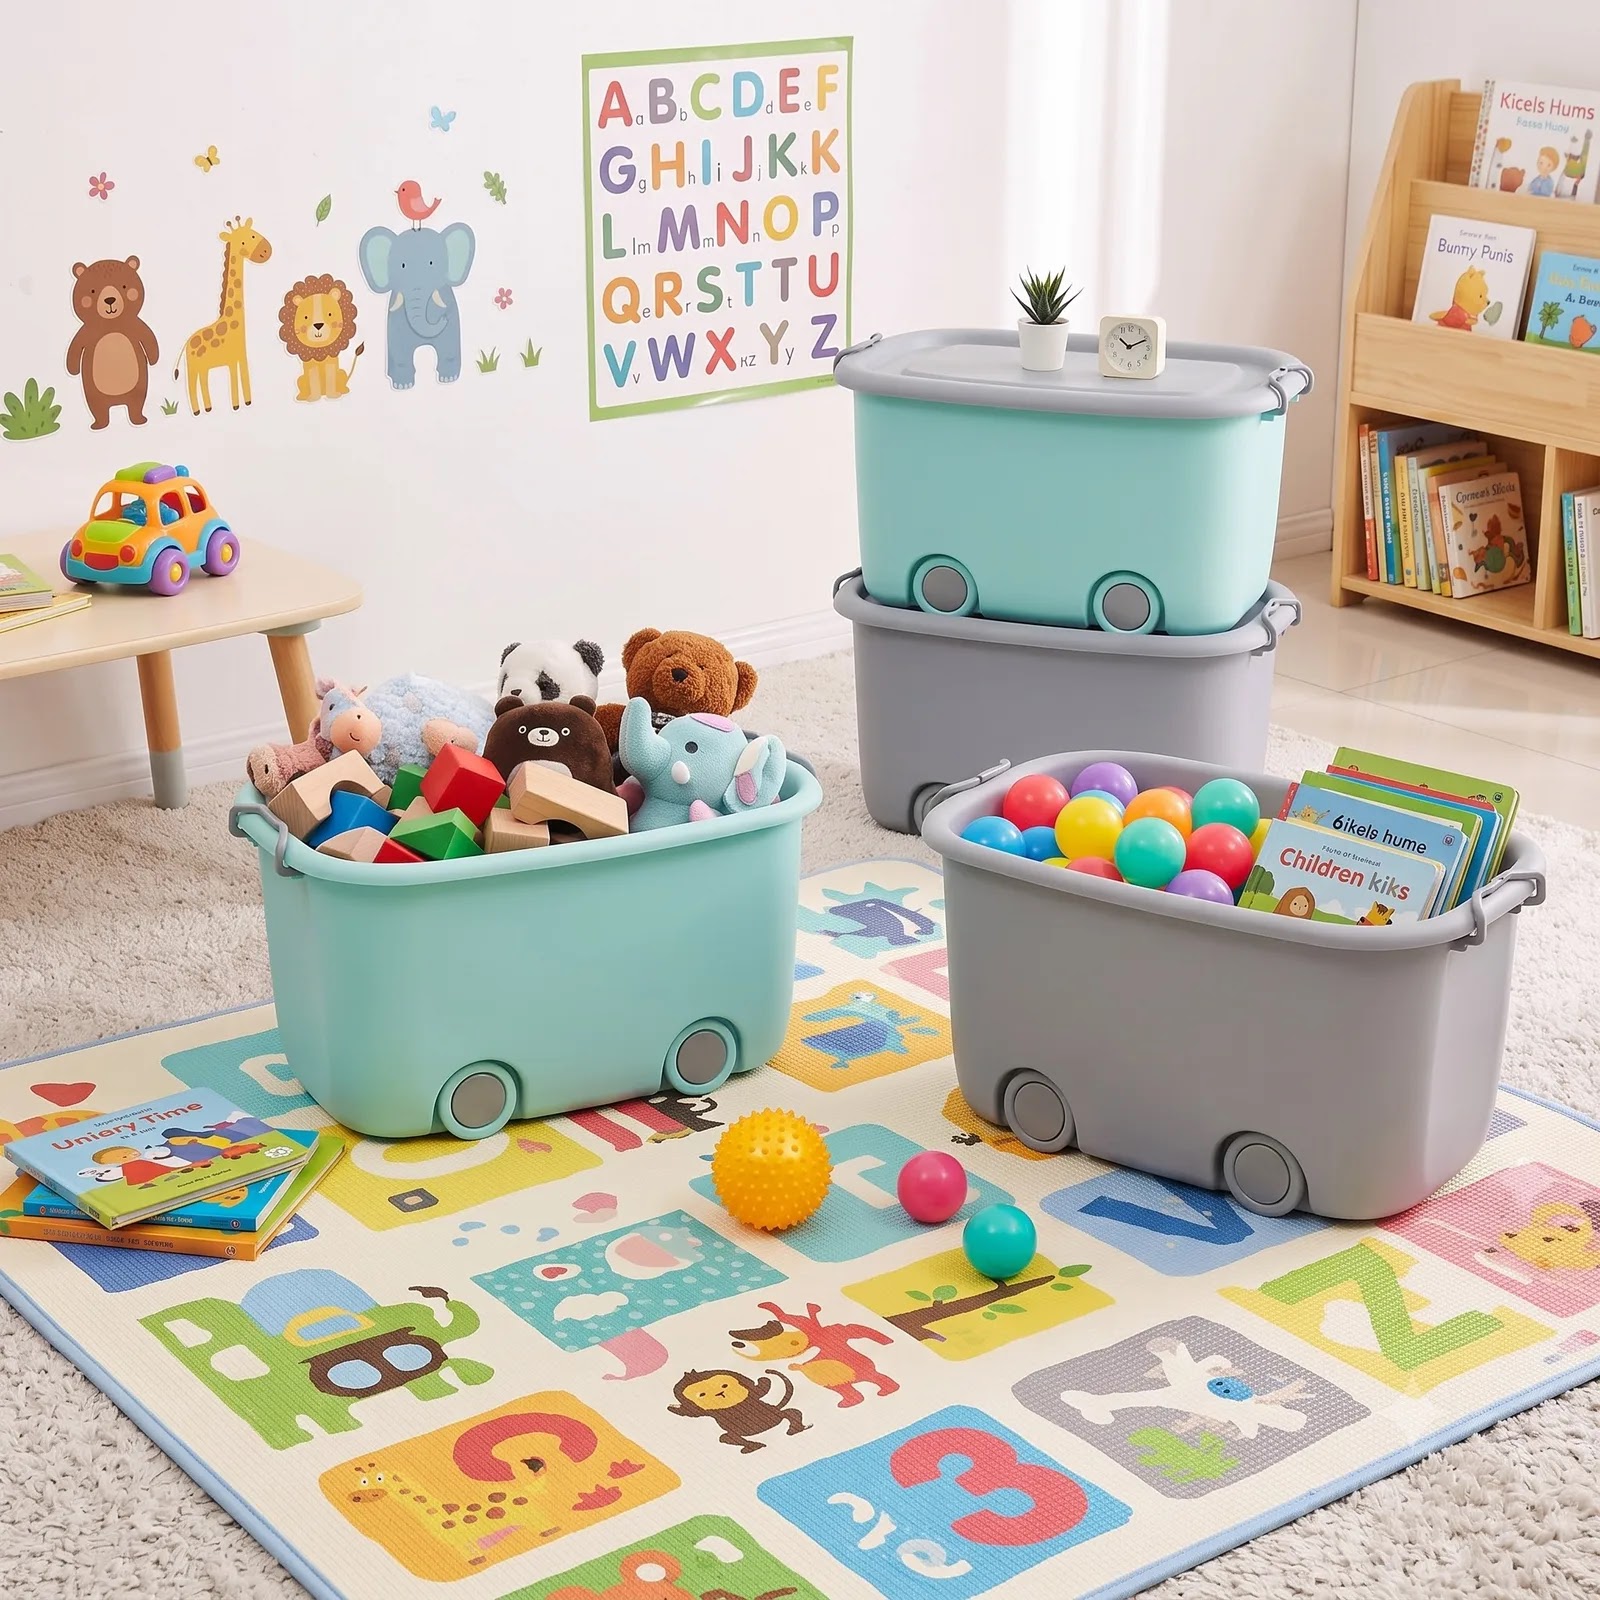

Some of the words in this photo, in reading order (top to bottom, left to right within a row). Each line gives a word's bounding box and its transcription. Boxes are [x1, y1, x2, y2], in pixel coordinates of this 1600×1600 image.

[598, 81, 633, 129] A
[649, 78, 677, 124] B
[690, 73, 722, 121] C
[733, 71, 764, 117] D
[779, 68, 800, 113] E
[817, 64, 839, 111] F
[1550, 98, 1595, 120] Hums
[600, 146, 636, 194] G
[651, 141, 685, 190] H
[702, 139, 711, 185] I
[732, 135, 752, 182] J
[769, 132, 797, 179] K
[812, 128, 840, 175] K
[603, 213, 626, 259] L
[657, 205, 700, 253] M
[717, 200, 749, 247] N
[763, 195, 798, 241] O
[813, 191, 839, 236] P
[602, 277, 641, 324] Q
[655, 271, 683, 319] R
[697, 266, 723, 313] S
[736, 261, 762, 306] T
[772, 257, 797, 302] T
[808, 252, 839, 297] U
[603, 340, 636, 388] V
[648, 332, 695, 381] W
[705, 327, 736, 375] X
[759, 320, 789, 365] Y
[811, 313, 839, 359] Z
[1279, 847, 1365, 887] Children
[1368, 871, 1410, 900] kiks
[1382, 829, 1427, 854] hume
[138, 1103, 203, 1124] Time
[890, 1426, 1089, 1547] 3
